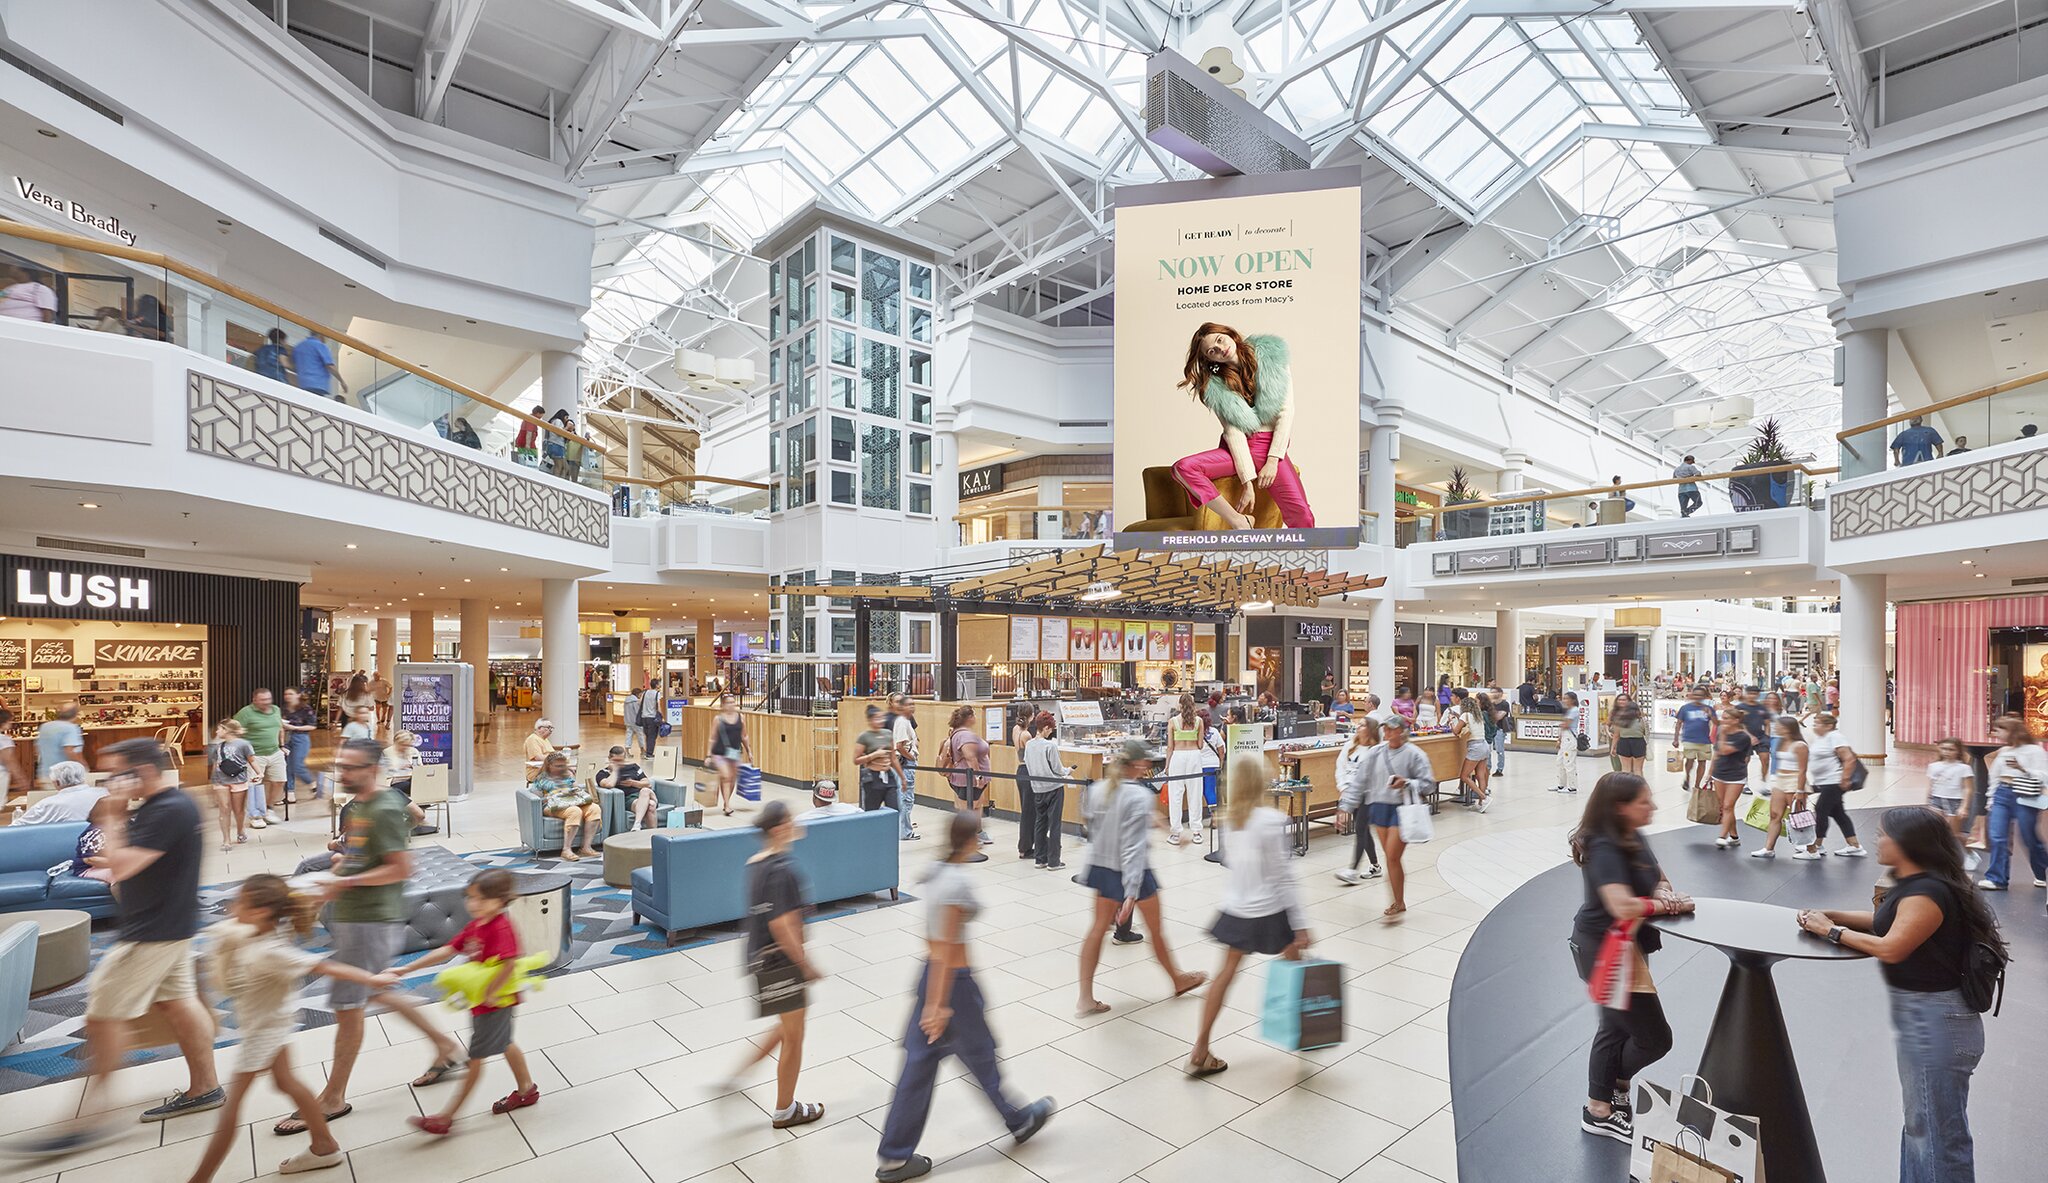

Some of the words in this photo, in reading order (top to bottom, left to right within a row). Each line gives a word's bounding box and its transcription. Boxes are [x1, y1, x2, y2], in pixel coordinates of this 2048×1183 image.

[70, 201, 137, 247] Bradley
[1184, 232, 1202, 240] GET
[1204, 229, 1233, 239] READY
[1253, 226, 1286, 234] decorate
[1157, 255, 1225, 280] NOW
[1234, 248, 1314, 275] OPEN
[1177, 285, 1209, 295] HOME
[1213, 282, 1252, 293] DECOR
[1255, 279, 1293, 290] STORE
[1176, 301, 1211, 310] Located
[1212, 299, 1240, 307] across
[1242, 296, 1263, 305] from
[1264, 295, 1294, 304] Macy's
[963, 470, 991, 489] KAY
[963, 484, 991, 496] JEWELERS
[1162, 535, 1218, 545] FREEHOLD
[1220, 534, 1273, 544] RACEWAY
[1275, 533, 1306, 543] MALL
[17, 569, 149, 610] LUSH
[1198, 574, 1320, 608] STARBUCKS
[318, 618, 330, 634] Lids
[1458, 631, 1478, 641] ALDO
[32, 654, 72, 664] DEMO
[96, 644, 200, 662] SKINCARE
[402, 704, 425, 715] JUAN
[426, 704, 450, 715] SOTO
[402, 722, 430, 731] FIGURINE
[430, 722, 449, 731] NIGHT
